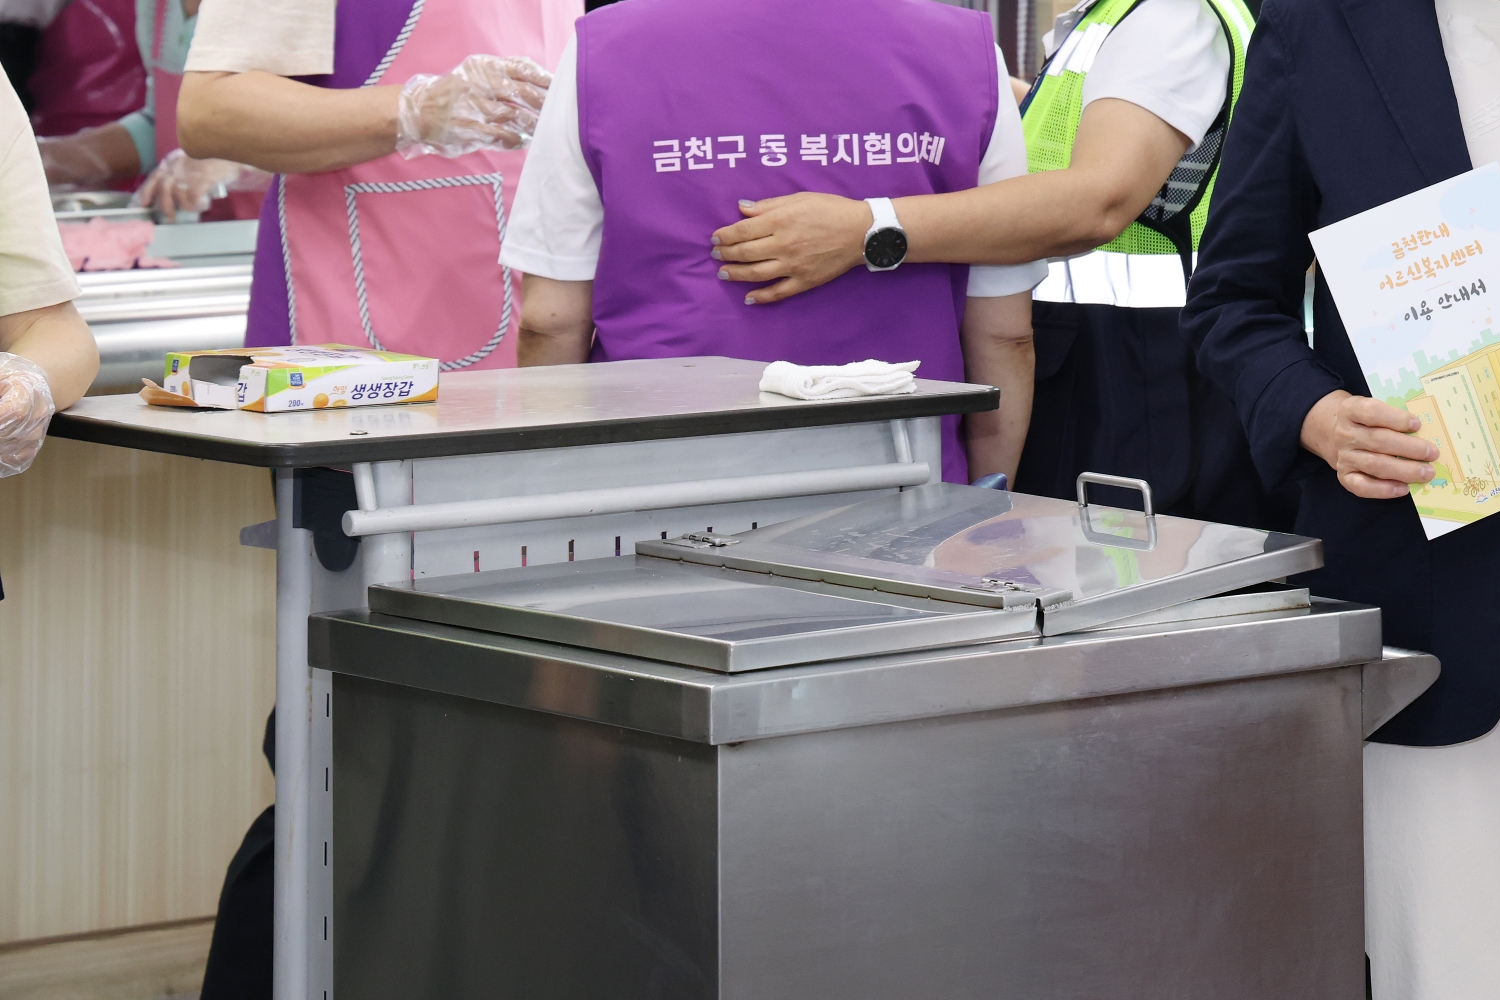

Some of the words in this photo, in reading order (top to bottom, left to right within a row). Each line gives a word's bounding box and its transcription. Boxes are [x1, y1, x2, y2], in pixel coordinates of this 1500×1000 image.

[652, 135, 747, 173] 금천구
[759, 134, 788, 167] 동
[799, 132, 946, 166] 복지협의체
[1391, 222, 1450, 260] 금천한내
[1379, 239, 1483, 290] 어르신복지센터
[1404, 300, 1433, 321] 이용
[1438, 278, 1487, 309] 안내서
[351, 380, 414, 400] 생생장갑
